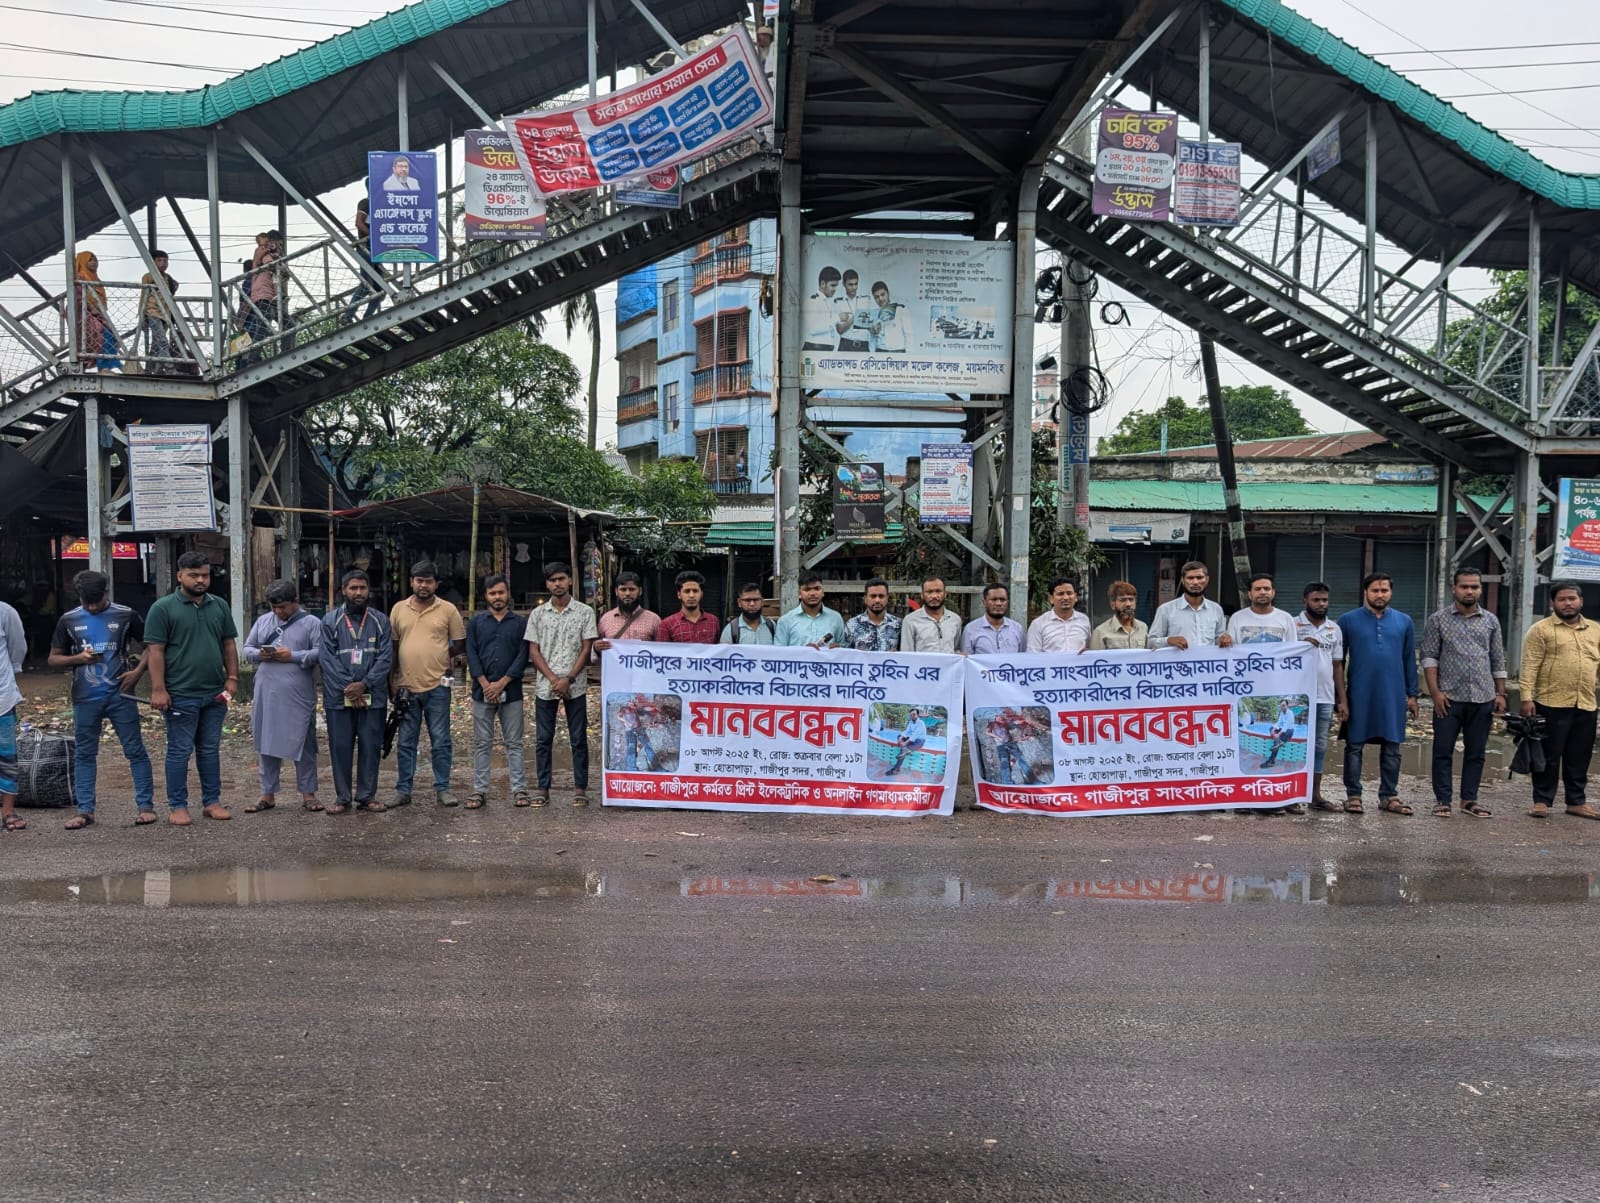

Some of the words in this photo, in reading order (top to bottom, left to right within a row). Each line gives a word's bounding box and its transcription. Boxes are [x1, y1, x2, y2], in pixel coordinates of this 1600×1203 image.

[595, 100, 627, 121] সকল
[627, 86, 662, 106] শাখায়
[663, 69, 693, 92] সমান
[694, 53, 720, 75] সেবা
[1106, 114, 1141, 134] ঢাবি
[1123, 134, 1160, 151] 95%
[483, 147, 520, 167] উন্মে
[1181, 147, 1217, 160] BIST
[539, 166, 592, 185] উন্মেষ
[912, 360, 932, 373] মডেল
[966, 360, 1006, 375] ময়মনসিংহ
[1574, 506, 1597, 519] পর্যন্ত
[618, 653, 681, 671] গাজীপুরে
[687, 652, 756, 674] সাংবাদিক
[762, 659, 863, 680] আসাদুজ্জামান
[869, 659, 909, 681] তুহিন
[914, 666, 939, 681] এর
[982, 665, 1045, 687] গাজীপুরে
[1051, 659, 1122, 680] সাংবাদিক
[1127, 656, 1228, 678] আসাদুজ্জামান
[1234, 653, 1274, 675] তুহিন
[1280, 656, 1303, 672] এর
[668, 677, 764, 696] হত্যাকারীদের
[769, 679, 830, 699] বিচারের
[837, 681, 887, 701] দাবিতে
[1033, 683, 1131, 705] হত্যাকারীদের
[1137, 680, 1197, 702] বিচারের
[1203, 677, 1254, 697] দাবিতে
[689, 702, 863, 748] মানববন্ধন
[1058, 704, 1231, 747] মানববন্ধন
[684, 749, 697, 758] ০৮
[700, 748, 724, 759] আগস্ট
[726, 749, 750, 760] ২০২৫
[794, 752, 823, 764] শুক্রবার
[844, 752, 863, 764] ১১টা
[1059, 759, 1071, 767] ০৮
[1073, 757, 1096, 767] আগস্ট
[1099, 756, 1123, 766] ২০২৫
[1166, 752, 1195, 763] শুক্রবার
[1216, 749, 1235, 760] ১১টা
[760, 763, 789, 777] গাজীপুর
[1134, 767, 1164, 779] গাজীপুর
[660, 781, 699, 798] গাজীপুরে
[702, 782, 732, 797] কর্মরত
[735, 781, 755, 798] প্রিন্ট
[813, 788, 821, 799] ও
[824, 788, 862, 803] অনলাইন
[1085, 785, 1149, 806] গাজীপুর
[1157, 781, 1235, 801] সাংবাদিক
